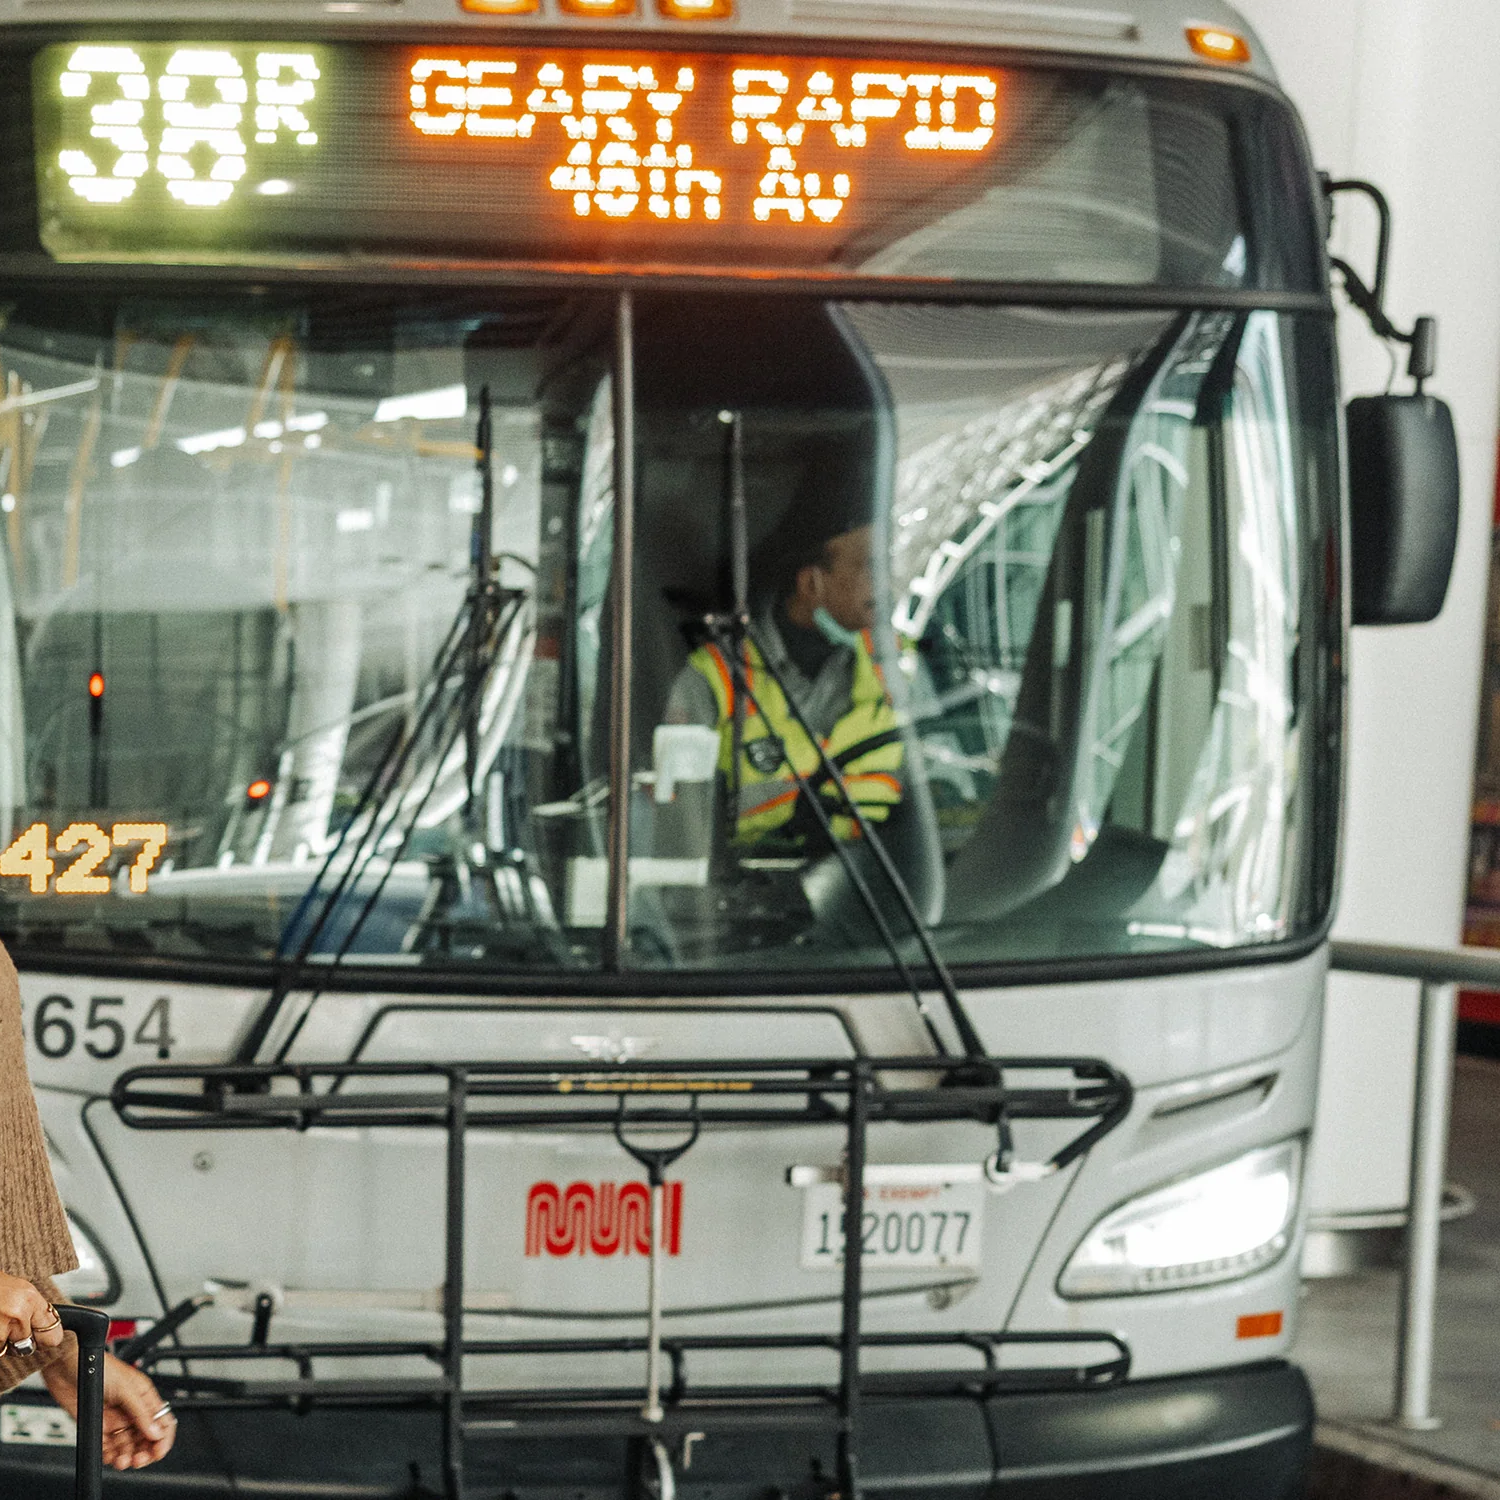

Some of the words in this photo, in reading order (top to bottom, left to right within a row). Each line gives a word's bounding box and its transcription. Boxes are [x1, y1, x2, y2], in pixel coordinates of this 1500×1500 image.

[58, 46, 321, 206] 38R
[410, 58, 694, 142] GEARY
[730, 68, 997, 150] RAPID
[753, 147, 850, 222] Av
[22, 994, 176, 1060] 654
[815, 1210, 971, 1255] 120077
